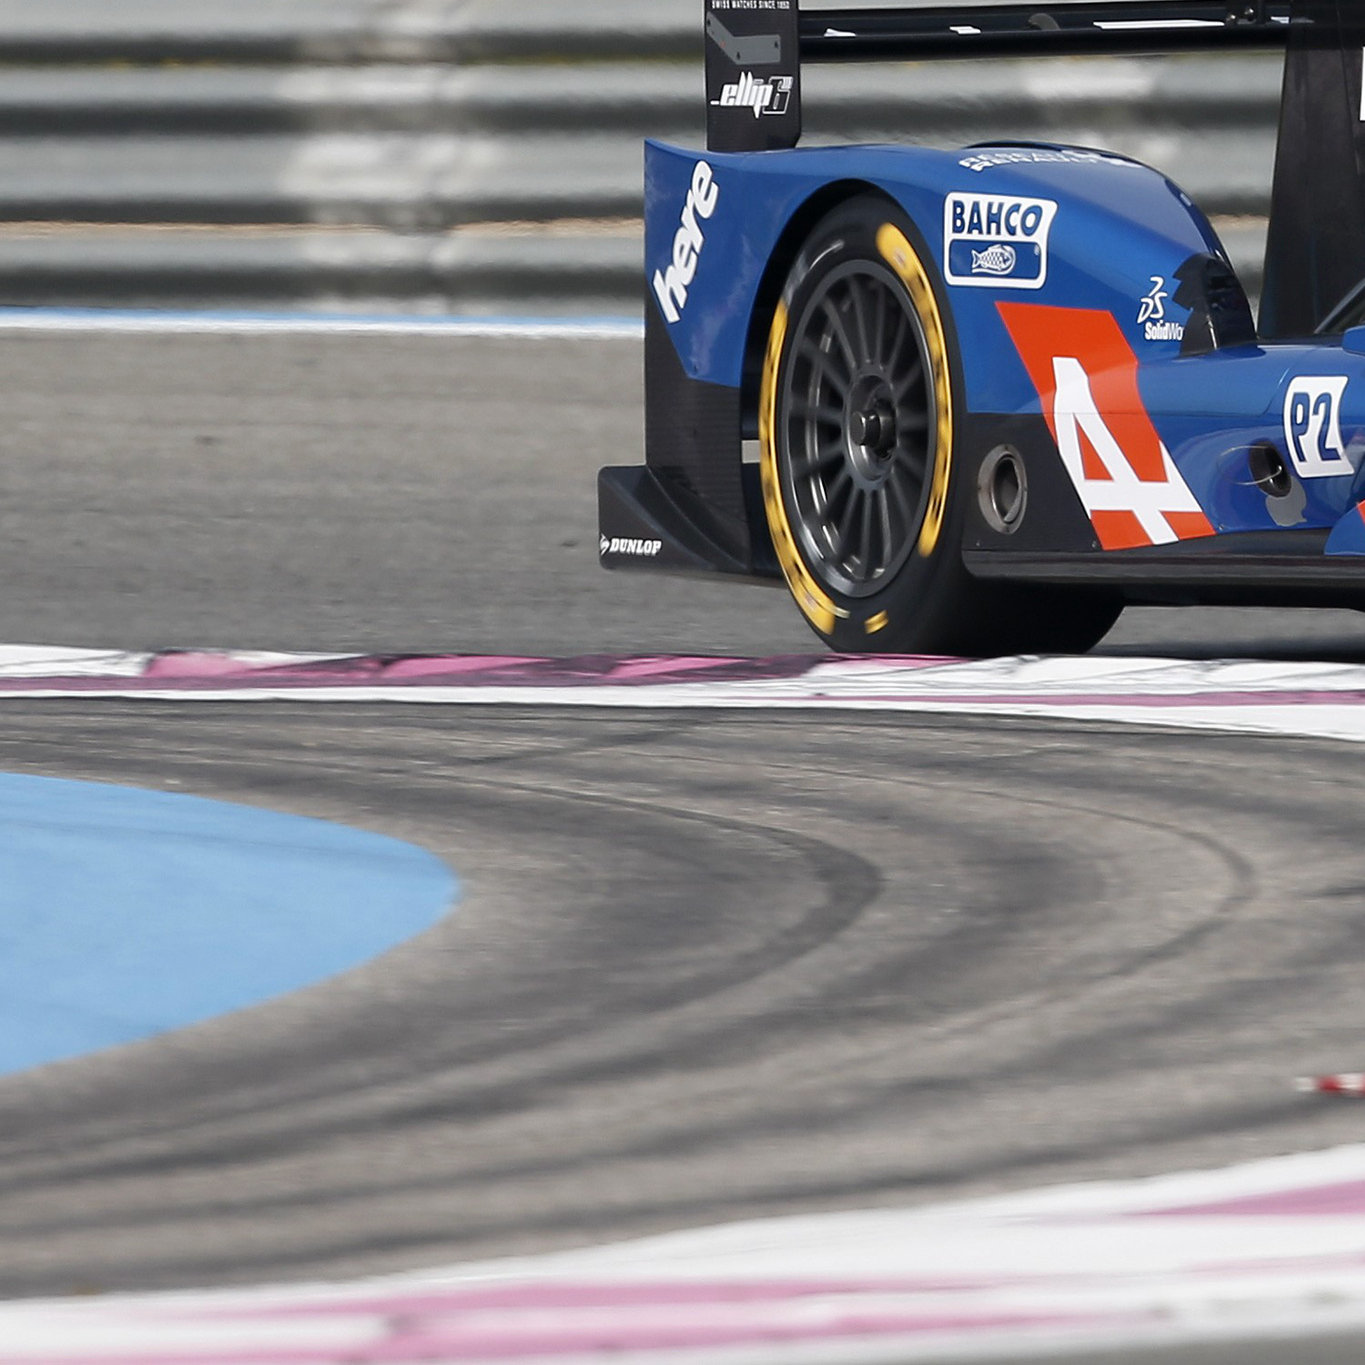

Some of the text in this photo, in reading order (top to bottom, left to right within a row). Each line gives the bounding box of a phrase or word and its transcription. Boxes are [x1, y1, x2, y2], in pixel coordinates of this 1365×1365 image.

[951, 200, 1043, 236] BAHCO
[653, 160, 719, 323] here
[1145, 319, 1184, 341] SolidWo
[1290, 391, 1342, 463] P2
[609, 537, 662, 555] DUNLOP
